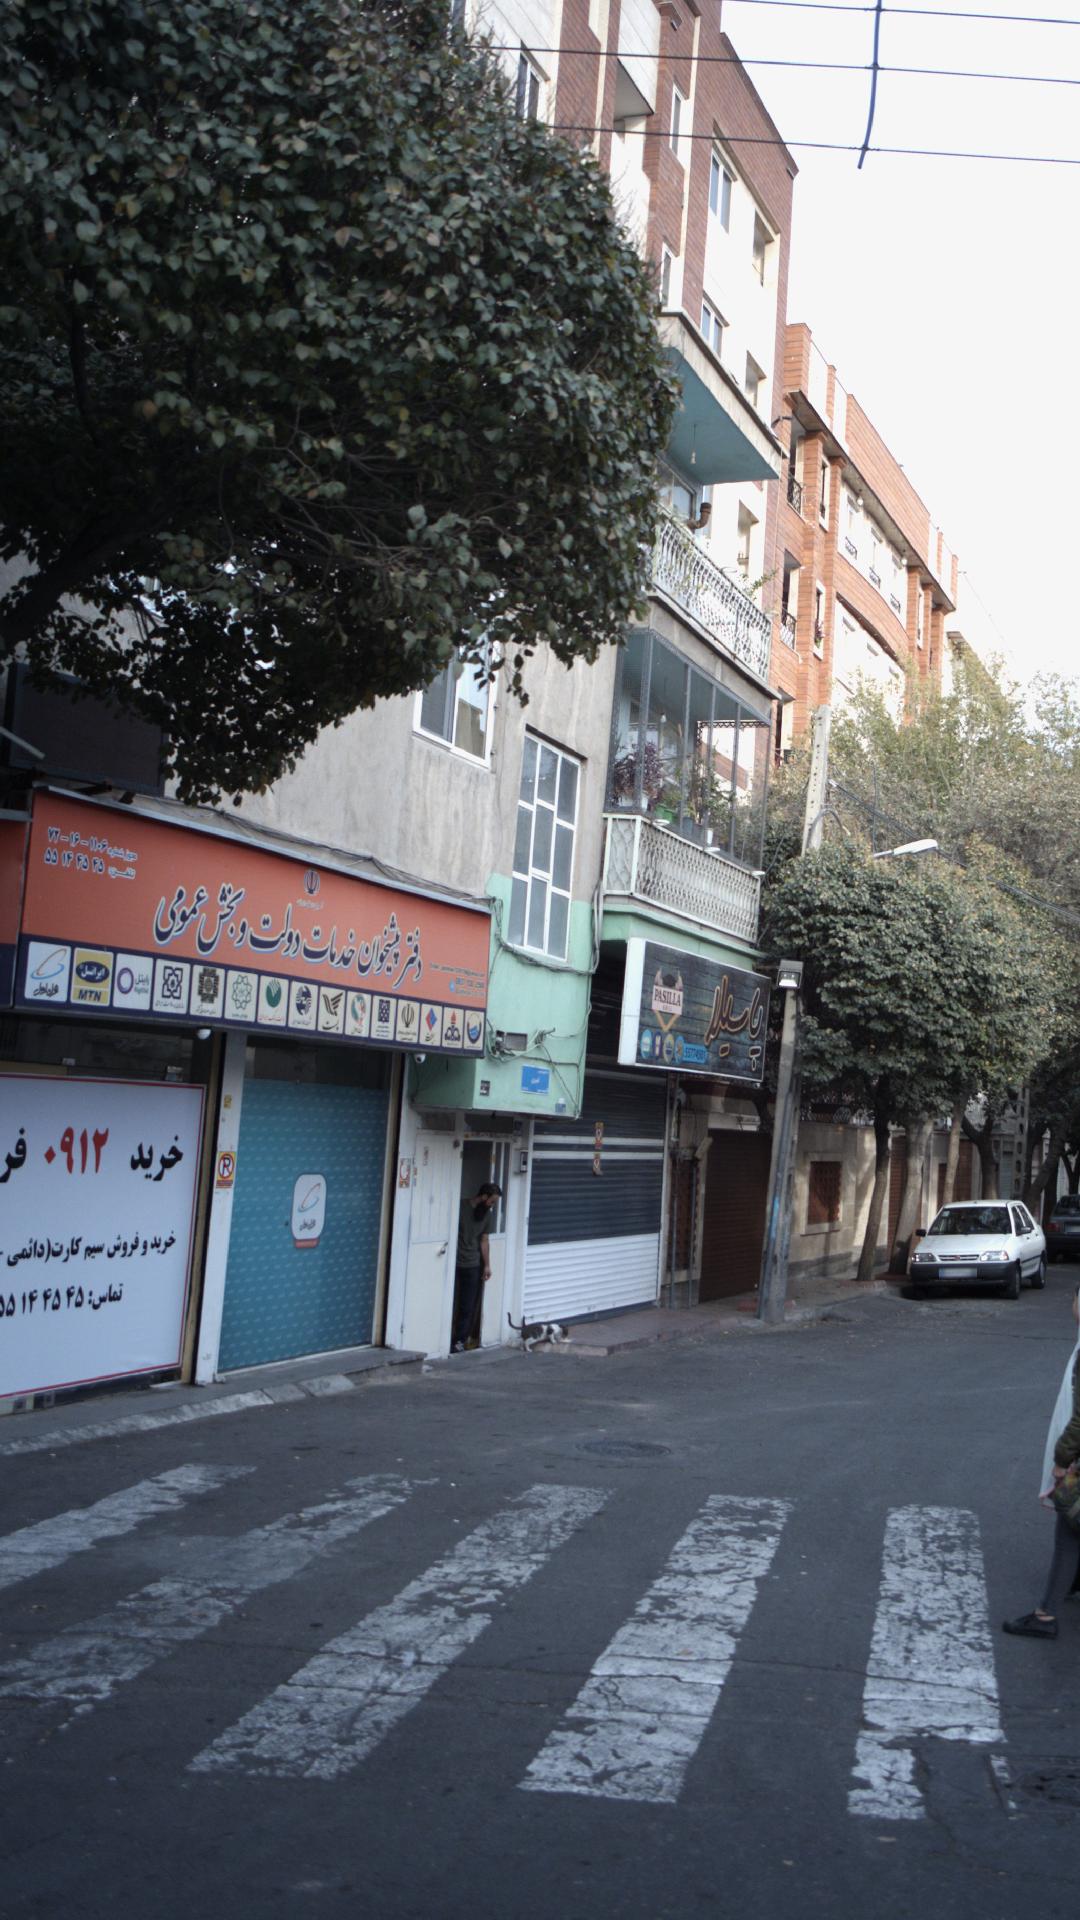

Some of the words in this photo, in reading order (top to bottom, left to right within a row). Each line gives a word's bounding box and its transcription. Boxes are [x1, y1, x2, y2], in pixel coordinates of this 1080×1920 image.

[152, 885, 209, 945] عمومی
[196, 882, 245, 956] بخش
[233, 917, 249, 948] و
[248, 902, 301, 958] دولت
[302, 927, 356, 969] خدمات
[357, 911, 401, 977] پیشخوان
[393, 927, 423, 989] دفتر
[80, 964, 106, 980] ایرانسل
[78, 989, 103, 1003] MTN
[654, 988, 682, 1007] PASILLA
[44, 1126, 109, 1174] ۰۹۱۲
[130, 1134, 184, 1181] خرید
[84, 1243, 105, 1261] سیم
[106, 1231, 140, 1258] فروش
[141, 1239, 149, 1256] و
[150, 1230, 177, 1255] خرید
[22, 1289, 38, 1315] ۱۴
[42, 1287, 62, 1312] ۴۵
[66, 1285, 85, 1309] ۴۵
[88, 1283, 124, 1311] تماس:
